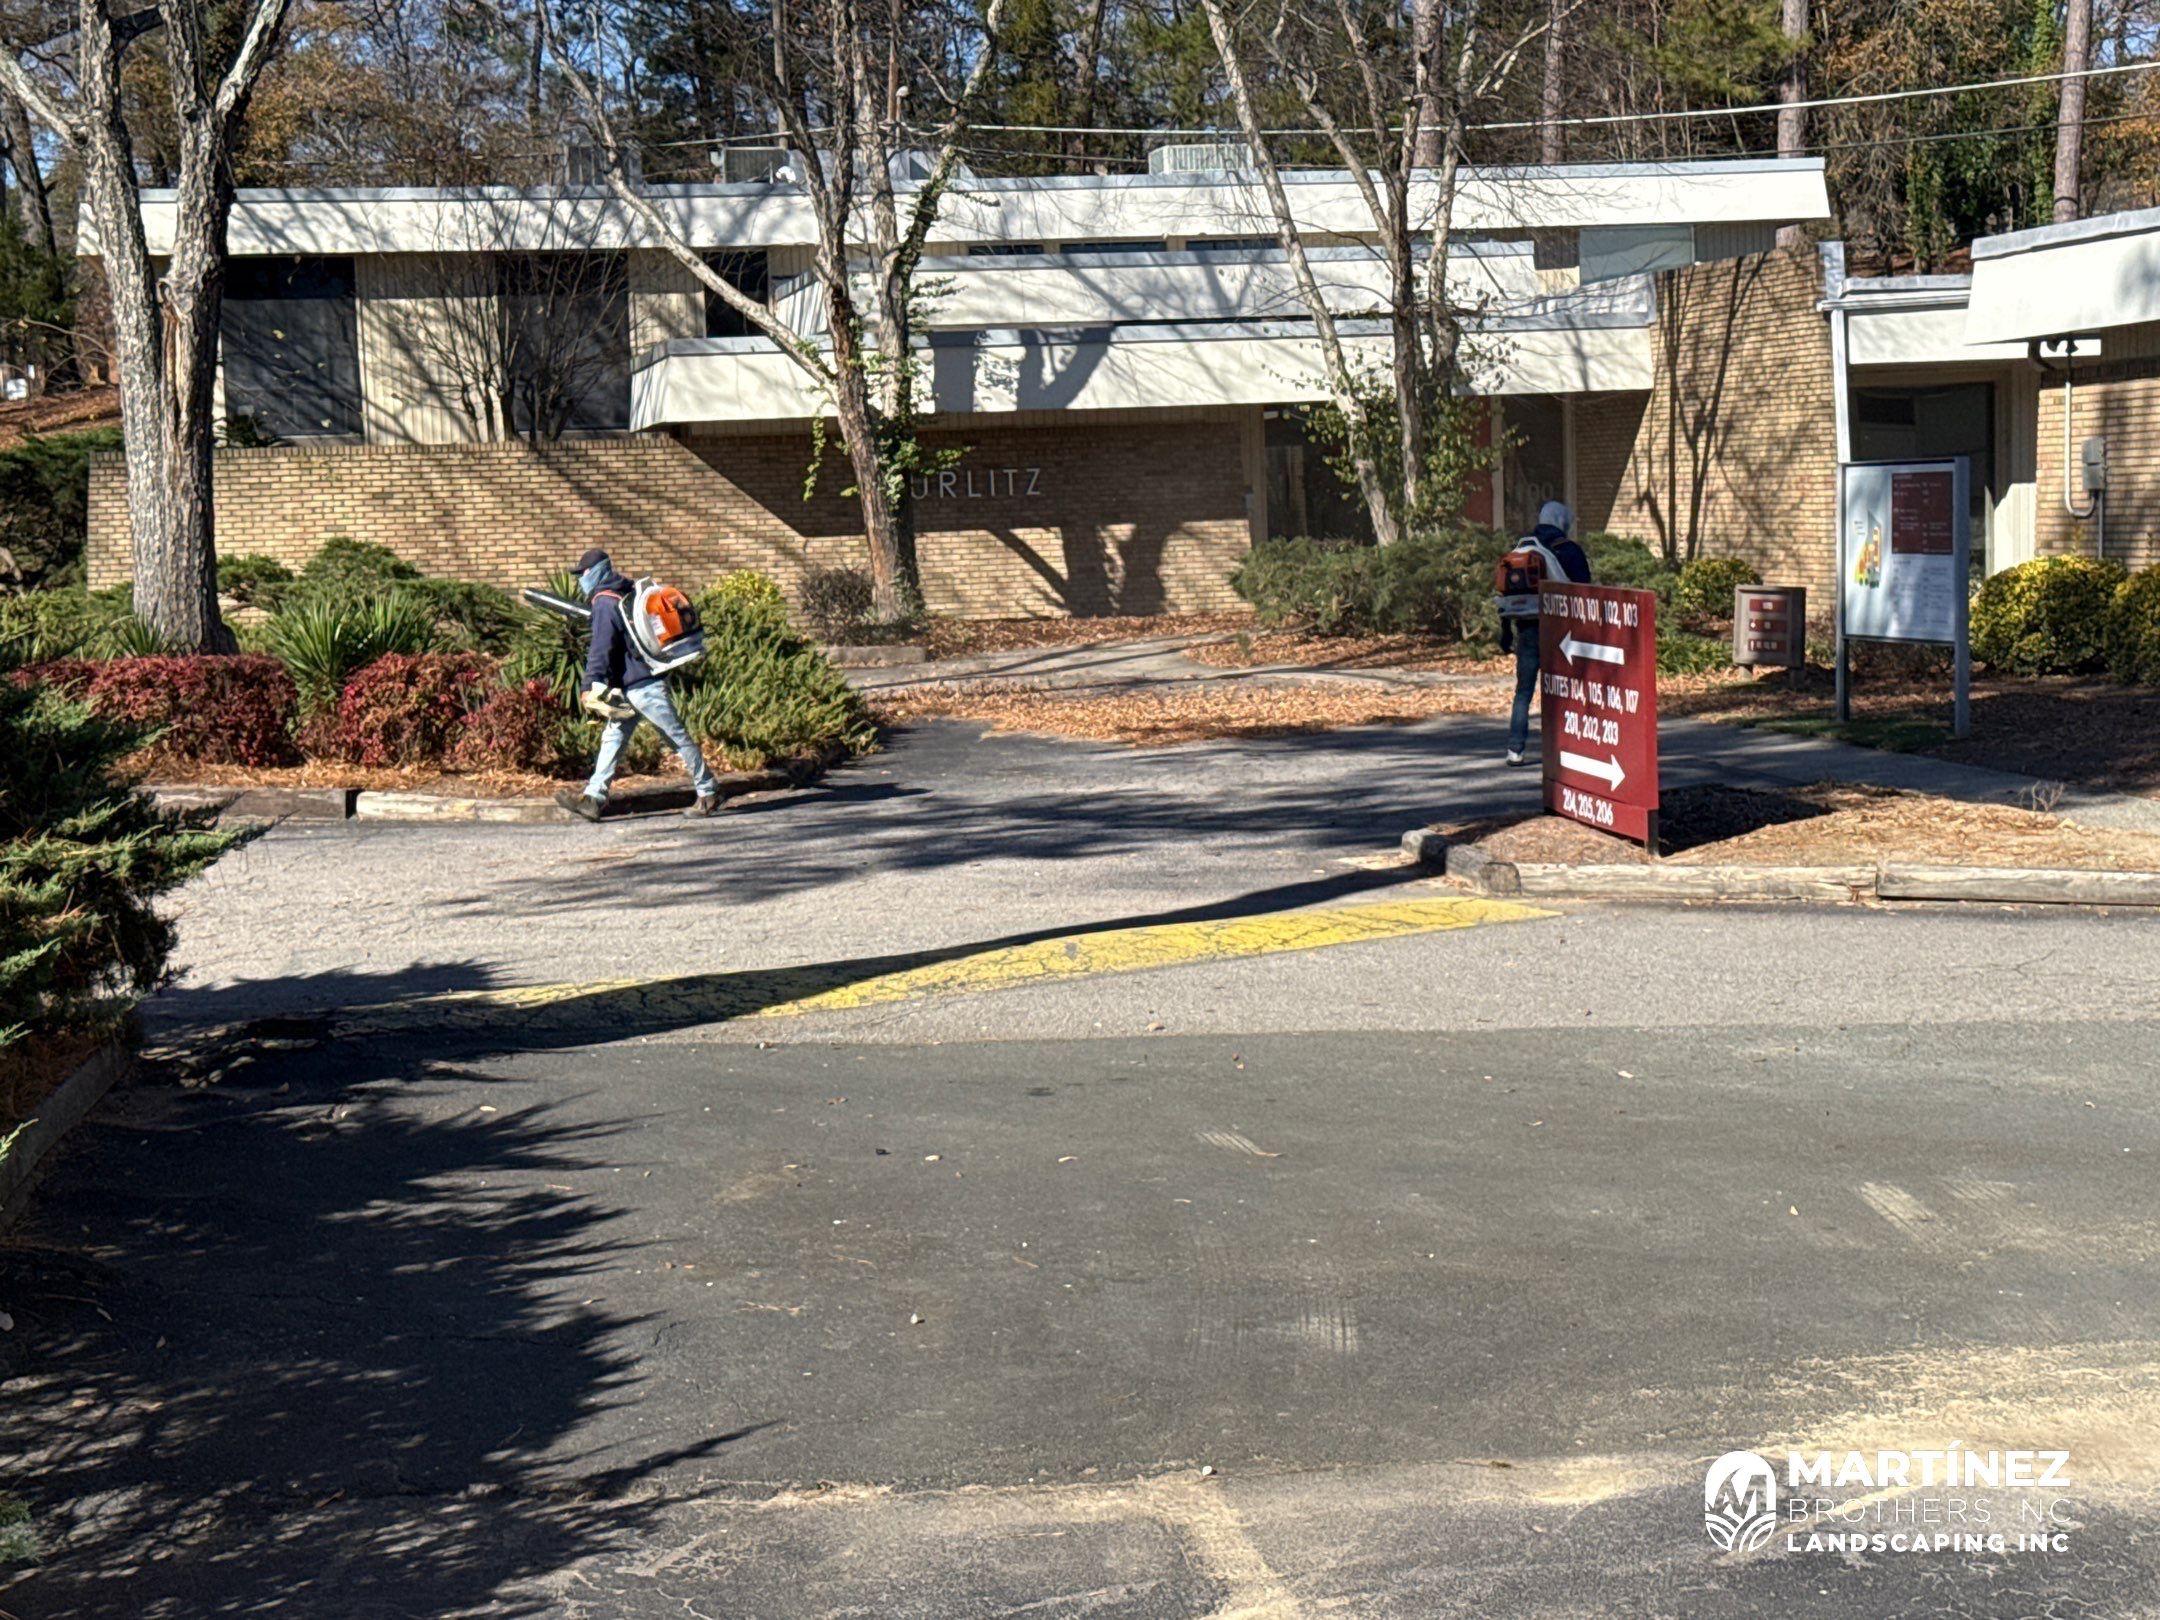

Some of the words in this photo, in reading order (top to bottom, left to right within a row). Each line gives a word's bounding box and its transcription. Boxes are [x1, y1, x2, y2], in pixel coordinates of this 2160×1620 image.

[910, 467, 1040, 500] URLITZ
[1543, 592, 1569, 618] SUITES
[1570, 596, 1585, 625] 100,
[1586, 598, 1602, 627] 101,
[1604, 600, 1621, 630] 102,
[1623, 602, 1638, 628] 103
[1544, 672, 1569, 698] SUITES
[1570, 678, 1586, 707] 104,
[1588, 681, 1605, 711] 105,
[1607, 685, 1623, 715] 106,
[1625, 688, 1639, 714] 107
[1564, 710, 1580, 741] 201,
[1582, 714, 1600, 746] 202,
[1602, 718, 1619, 746] 203
[1596, 799, 1614, 826] 206
